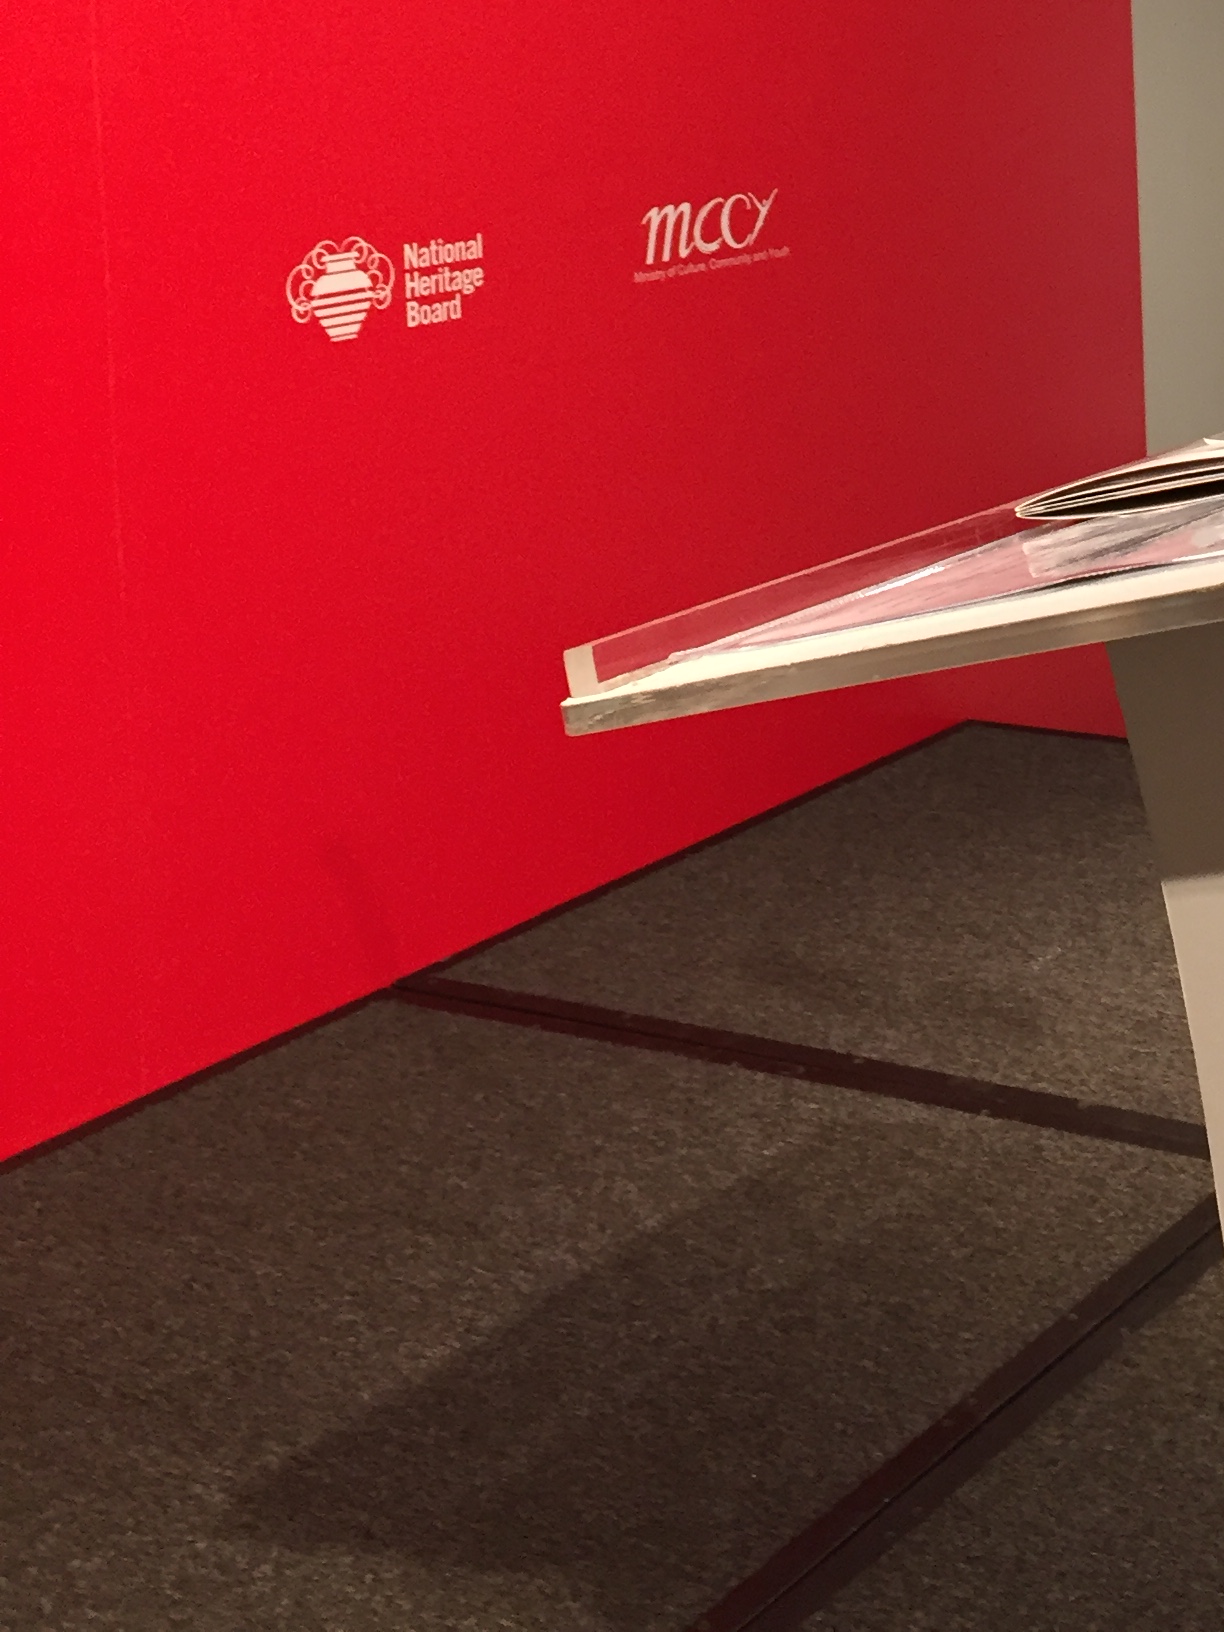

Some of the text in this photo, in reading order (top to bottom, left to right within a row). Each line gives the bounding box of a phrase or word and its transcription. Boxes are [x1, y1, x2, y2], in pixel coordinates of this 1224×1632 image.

[403, 232, 483, 270] National
[405, 266, 484, 299] Heritage
[406, 293, 462, 328] Board
